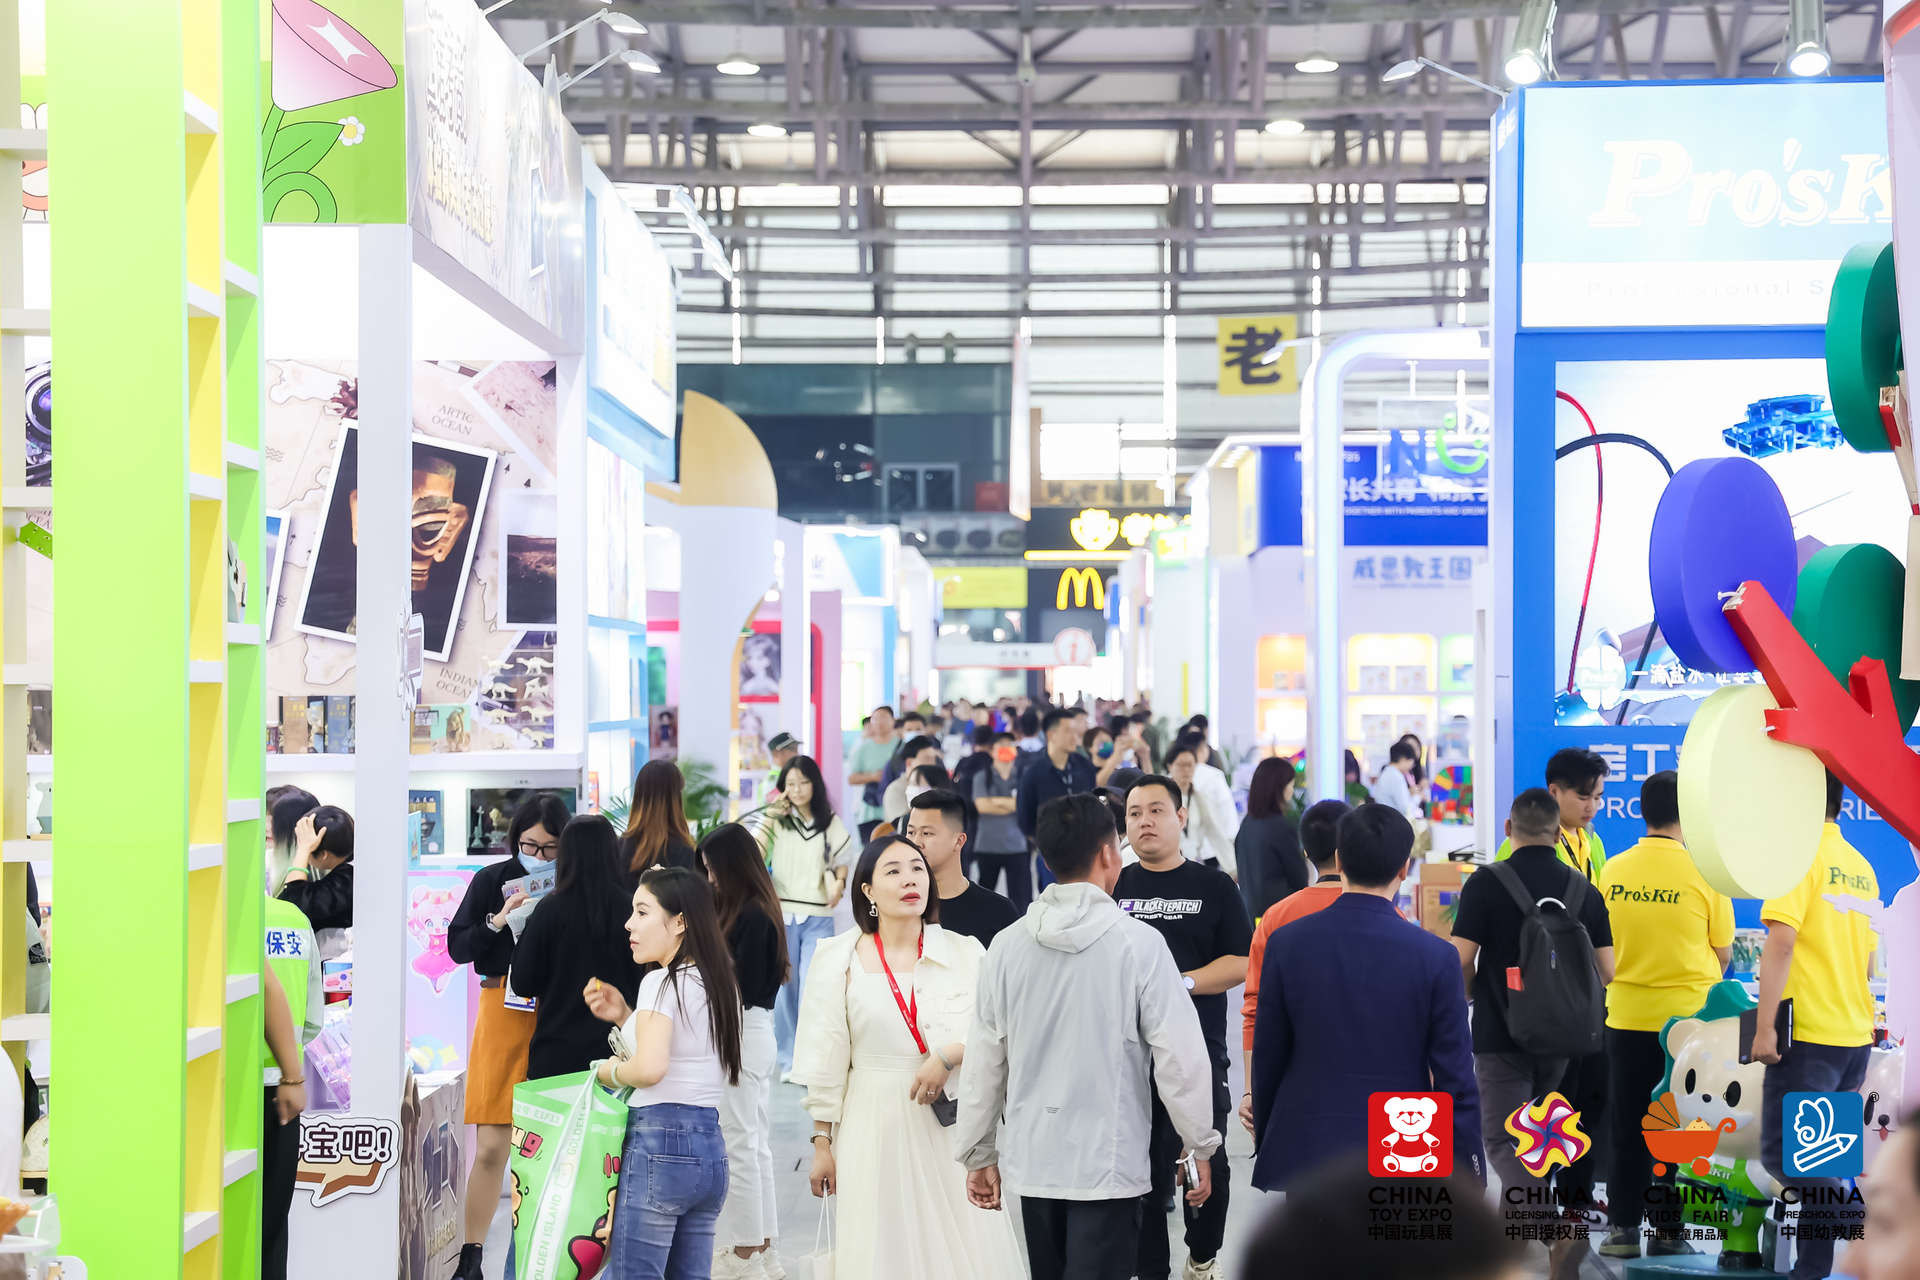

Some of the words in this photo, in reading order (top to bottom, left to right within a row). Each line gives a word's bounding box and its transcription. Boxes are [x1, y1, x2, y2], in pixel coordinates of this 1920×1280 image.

[1588, 138, 1892, 228] Pro'sK
[1807, 279, 1826, 297] S
[1225, 327, 1282, 385] 老
[431, 415, 472, 436] OCEAN
[440, 405, 472, 424] ARTIC
[1609, 884, 1681, 904] Pro'sKit
[1133, 900, 1199, 913] BLACKEYEPATCH
[266, 931, 302, 956] 保安
[299, 1127, 389, 1161] 宝吧!
[533, 1240, 551, 1280] OLDEN
